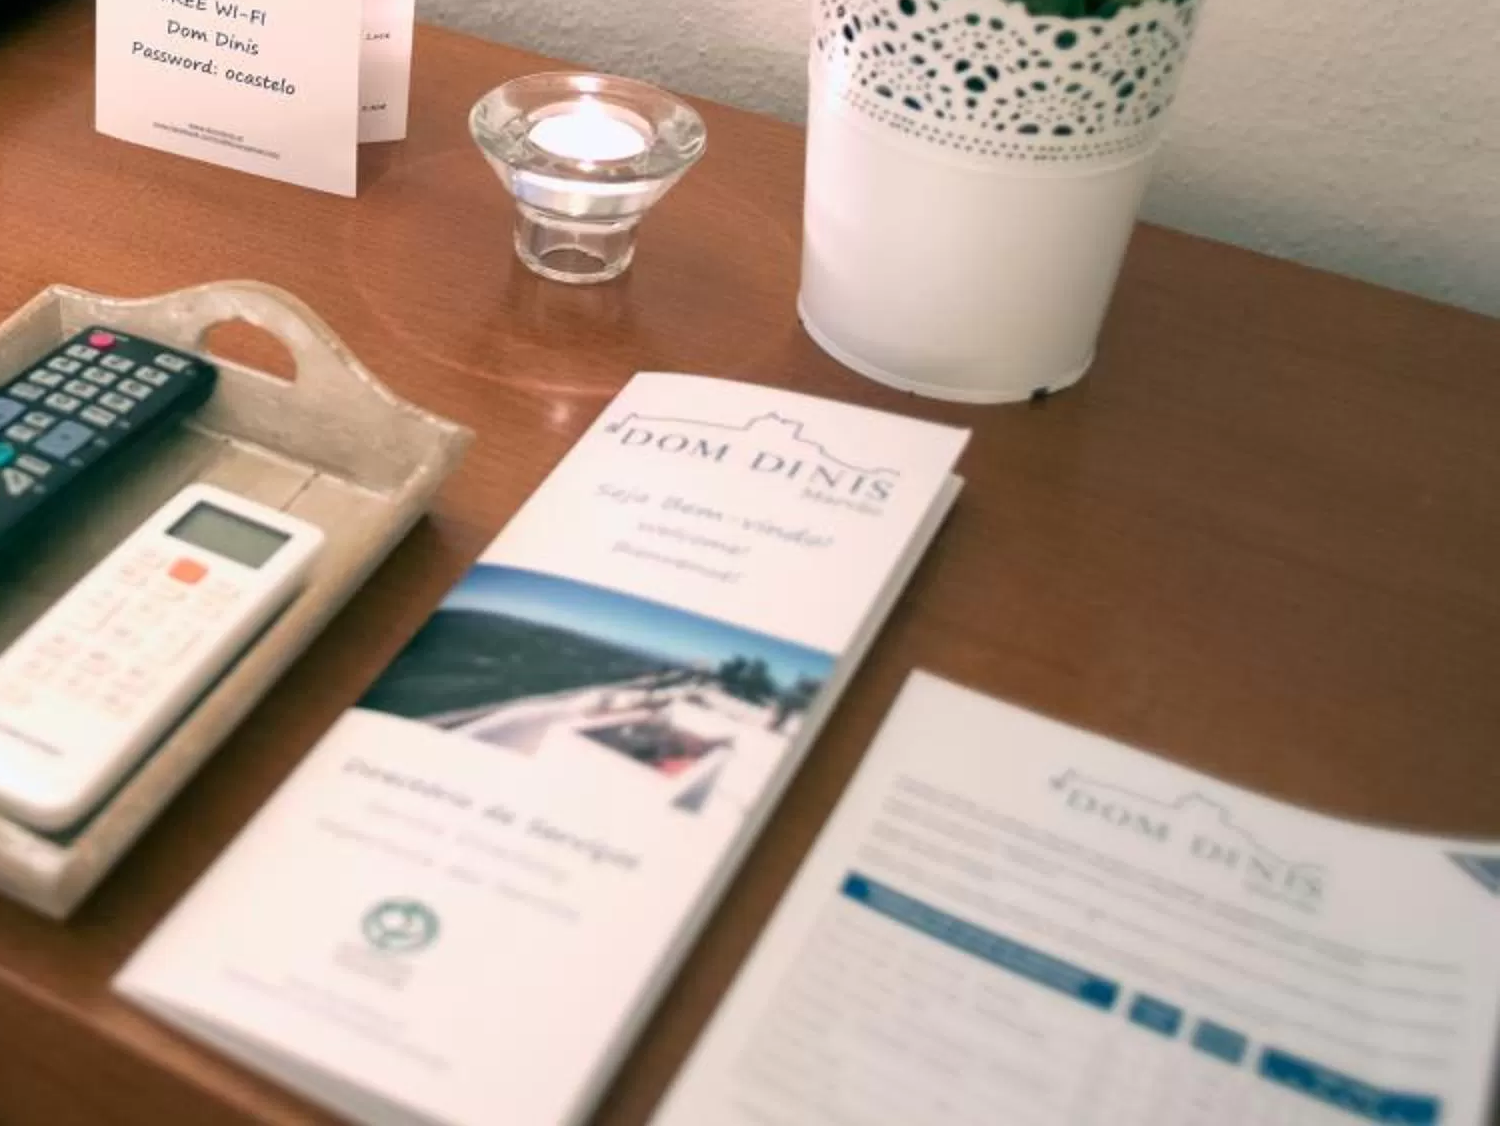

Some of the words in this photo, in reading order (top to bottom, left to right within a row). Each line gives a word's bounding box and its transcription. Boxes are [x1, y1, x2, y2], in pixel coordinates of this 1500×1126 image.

[215, 0, 267, 26] WI-FI
[166, 19, 208, 43] Dom
[215, 31, 259, 56] Dinis
[131, 41, 218, 75] Password:
[225, 68, 296, 95] ocastelo
[619, 427, 730, 464] DOM
[750, 450, 895, 502] DINIS
